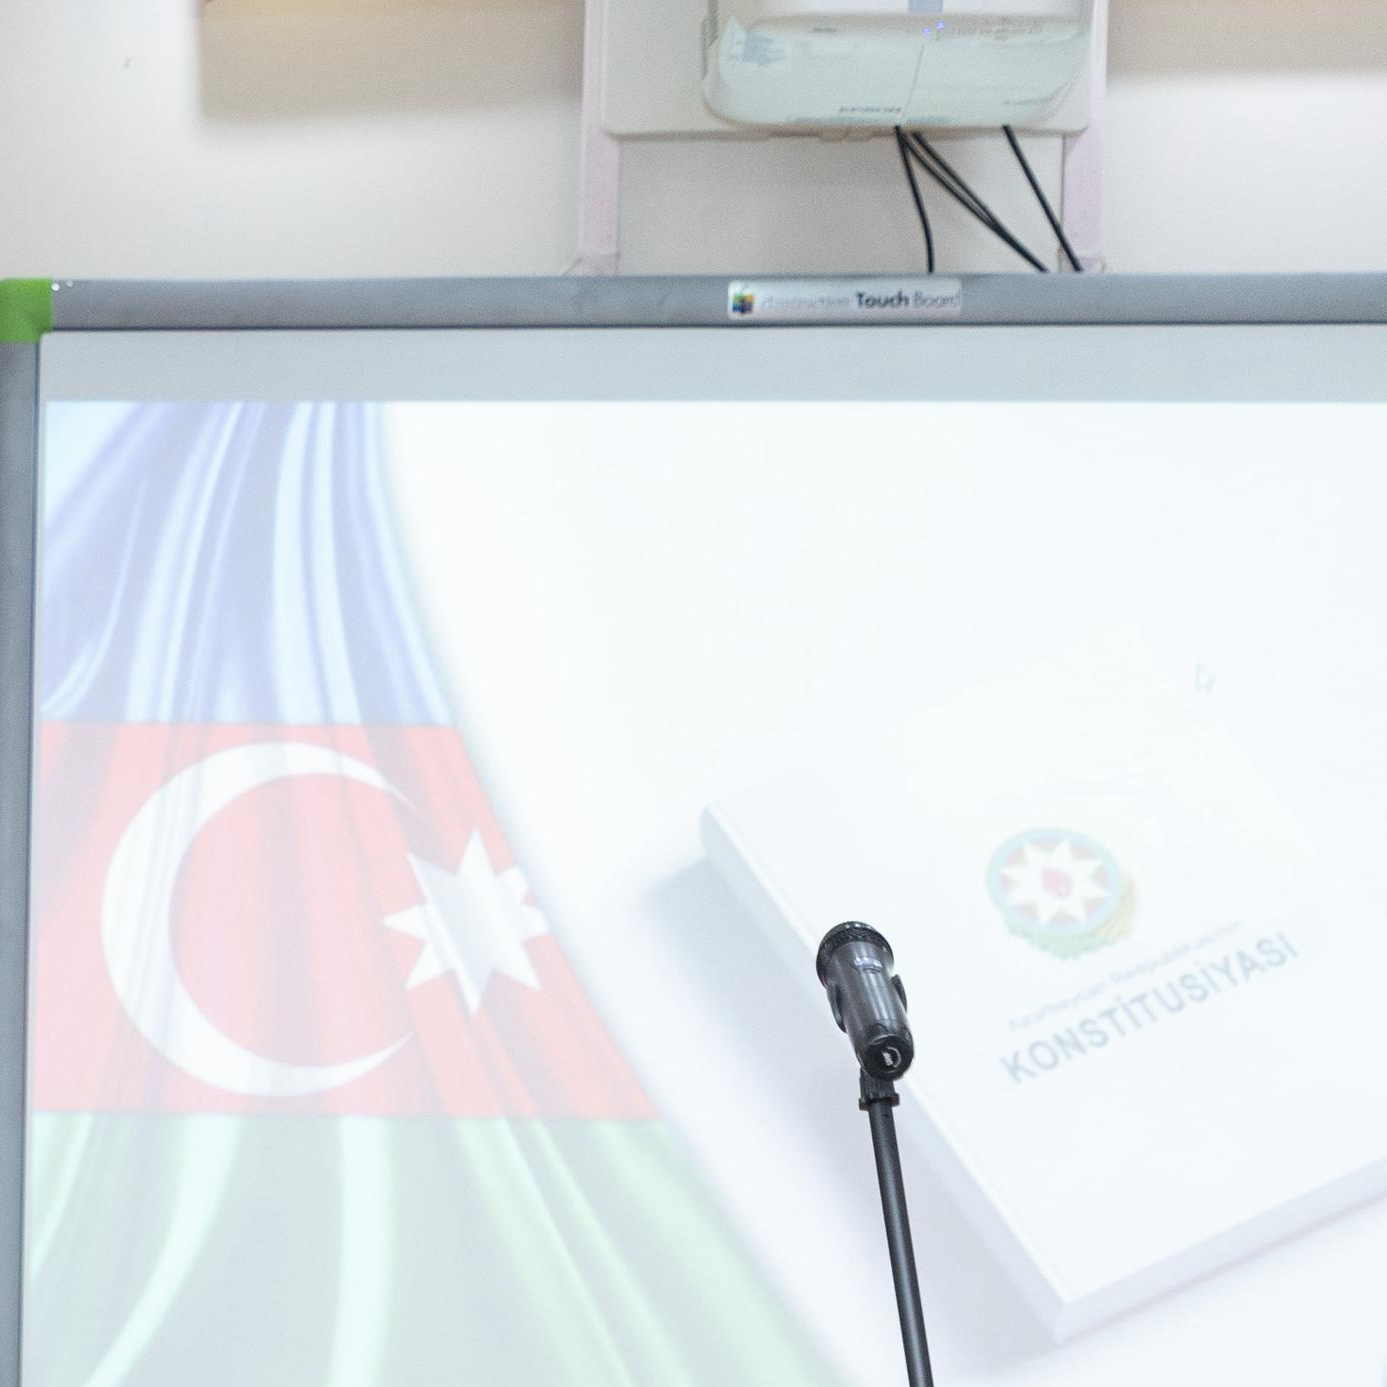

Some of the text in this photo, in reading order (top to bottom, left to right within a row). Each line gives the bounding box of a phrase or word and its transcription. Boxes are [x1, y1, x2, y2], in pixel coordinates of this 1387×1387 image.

[855, 290, 910, 309] Touch
[913, 290, 960, 309] Board
[999, 931, 1299, 1085] KONSTİTUSİYASI
